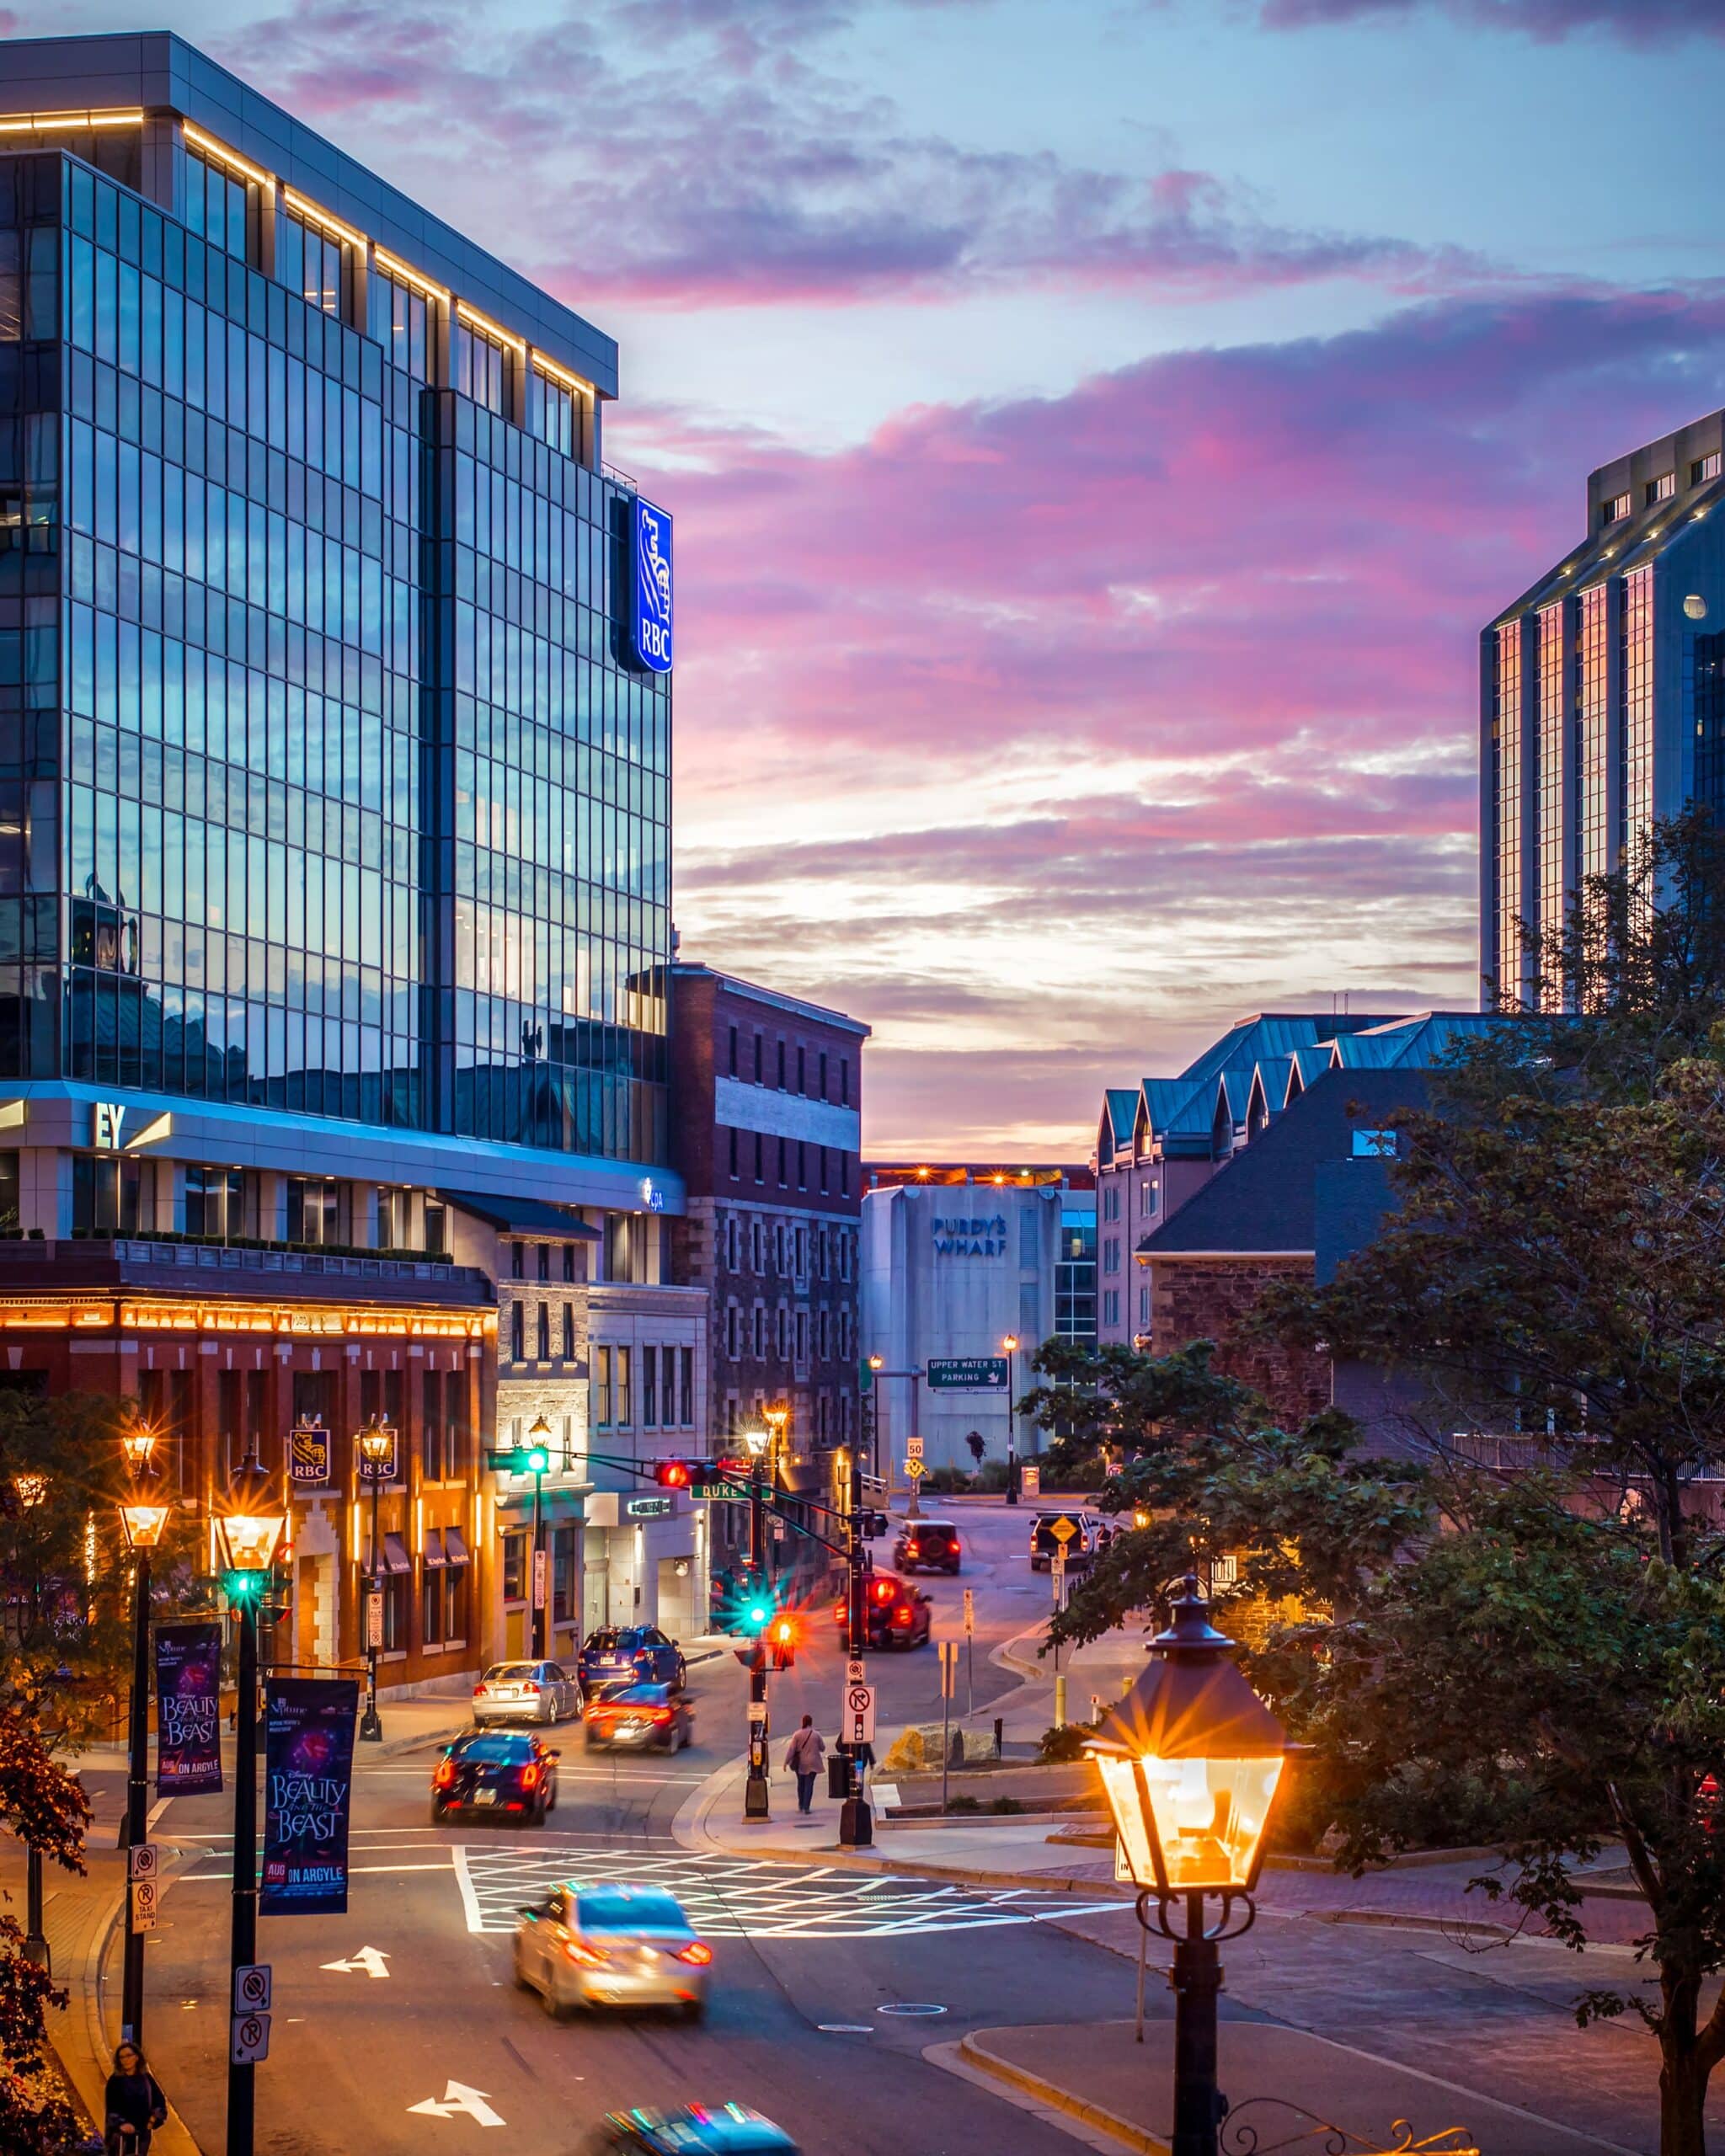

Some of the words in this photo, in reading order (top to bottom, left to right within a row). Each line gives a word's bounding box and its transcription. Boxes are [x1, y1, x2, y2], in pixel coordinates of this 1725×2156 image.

[642, 617, 670, 663] RBC
[95, 1102, 126, 1150] EY
[932, 1214, 1006, 1237] PURDY'S
[933, 1239, 1006, 1256] WHARF
[931, 1360, 959, 1369] UPPER
[961, 1360, 988, 1369] WATER
[909, 1444, 921, 1454] 50
[295, 1465, 324, 1476] RBC
[702, 1485, 738, 1497] DUKE
[163, 1696, 218, 1721] BEAUTY
[168, 1721, 216, 1746] BEAST
[179, 1764, 190, 1774] ON
[191, 1758, 218, 1774] ARGYLE
[272, 1774, 347, 1809] BEAUTY
[278, 1810, 344, 1843] BEAST
[268, 1864, 286, 1876] AUG
[288, 1869, 301, 1883] ON
[302, 1866, 344, 1883] ARGYLE
[136, 1912, 155, 1921] STAND
